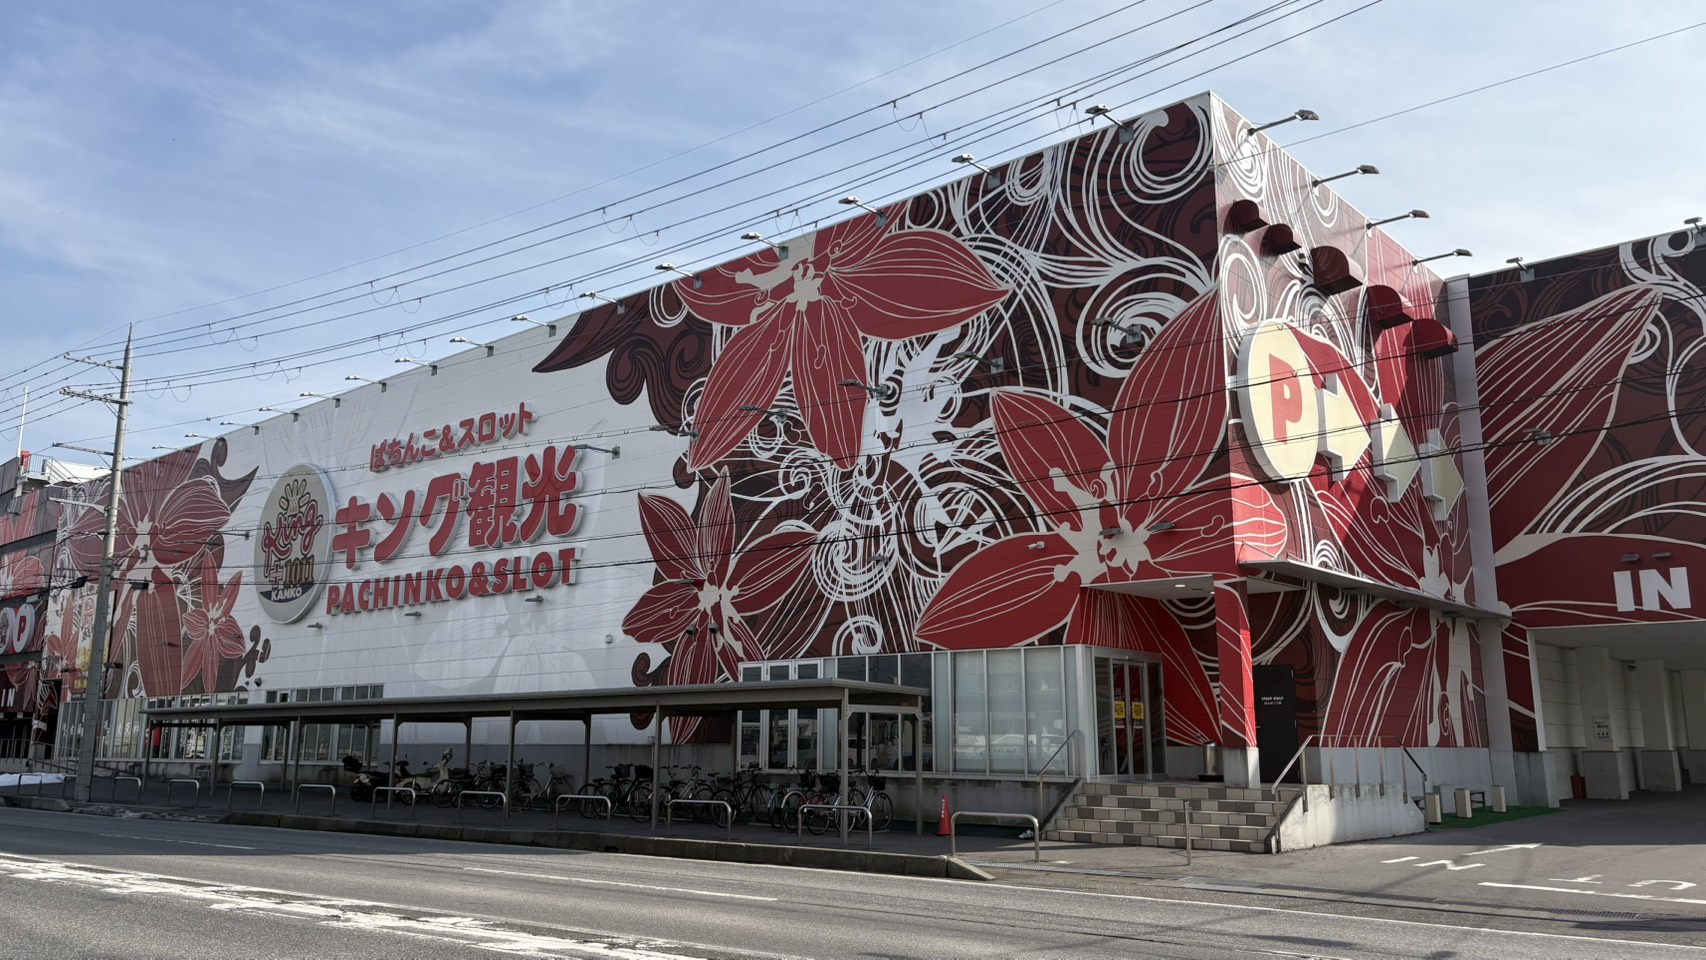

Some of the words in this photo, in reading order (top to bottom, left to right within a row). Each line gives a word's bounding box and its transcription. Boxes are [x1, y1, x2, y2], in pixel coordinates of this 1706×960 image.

[1269, 353, 1303, 445] P
[370, 402, 537, 473] ぱちんこ&スロット
[262, 500, 324, 578] King
[332, 445, 583, 570] キング観光
[271, 587, 302, 602] KANKO
[326, 548, 580, 615] PACHINKO&SLOT
[1613, 567, 1692, 612] IN
[17, 615, 26, 642] P
[1, 688, 15, 708] IN
